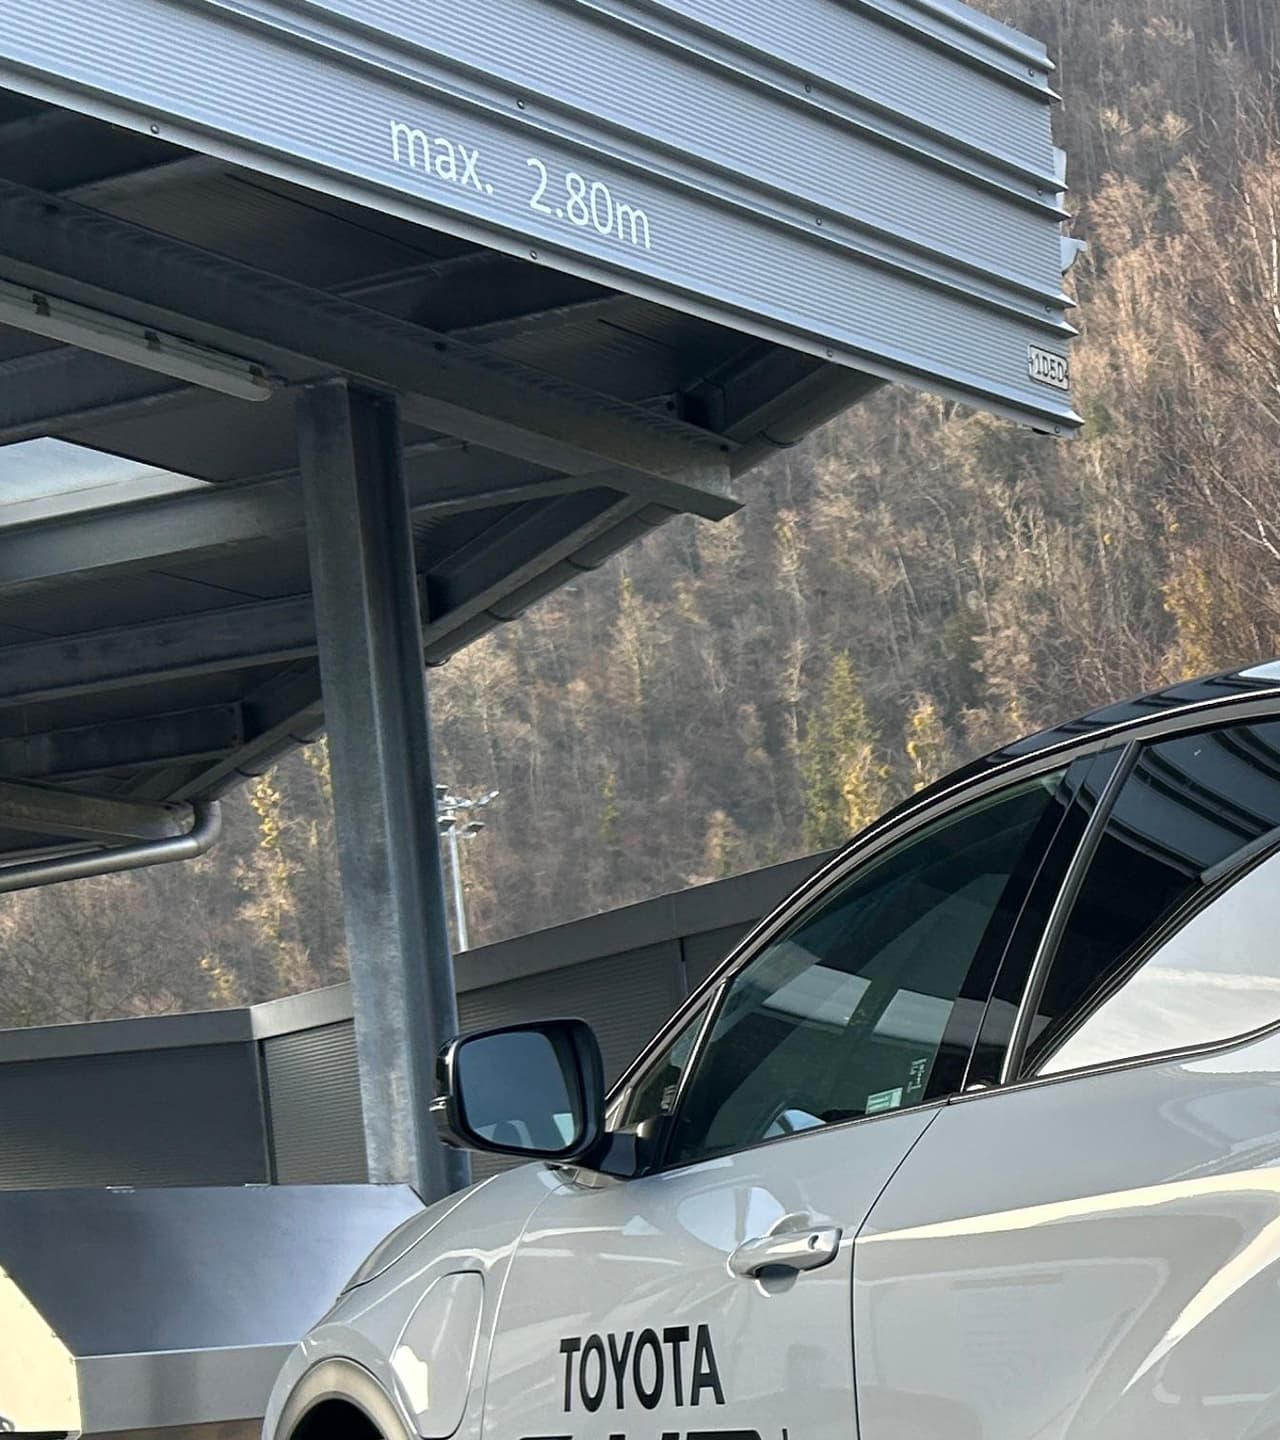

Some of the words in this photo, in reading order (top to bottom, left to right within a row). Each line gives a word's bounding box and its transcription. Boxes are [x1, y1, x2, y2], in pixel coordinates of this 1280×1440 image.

[390, 119, 493, 195] max.
[526, 157, 651, 249] 2.80m
[559, 1324, 726, 1413] TOYOTA
